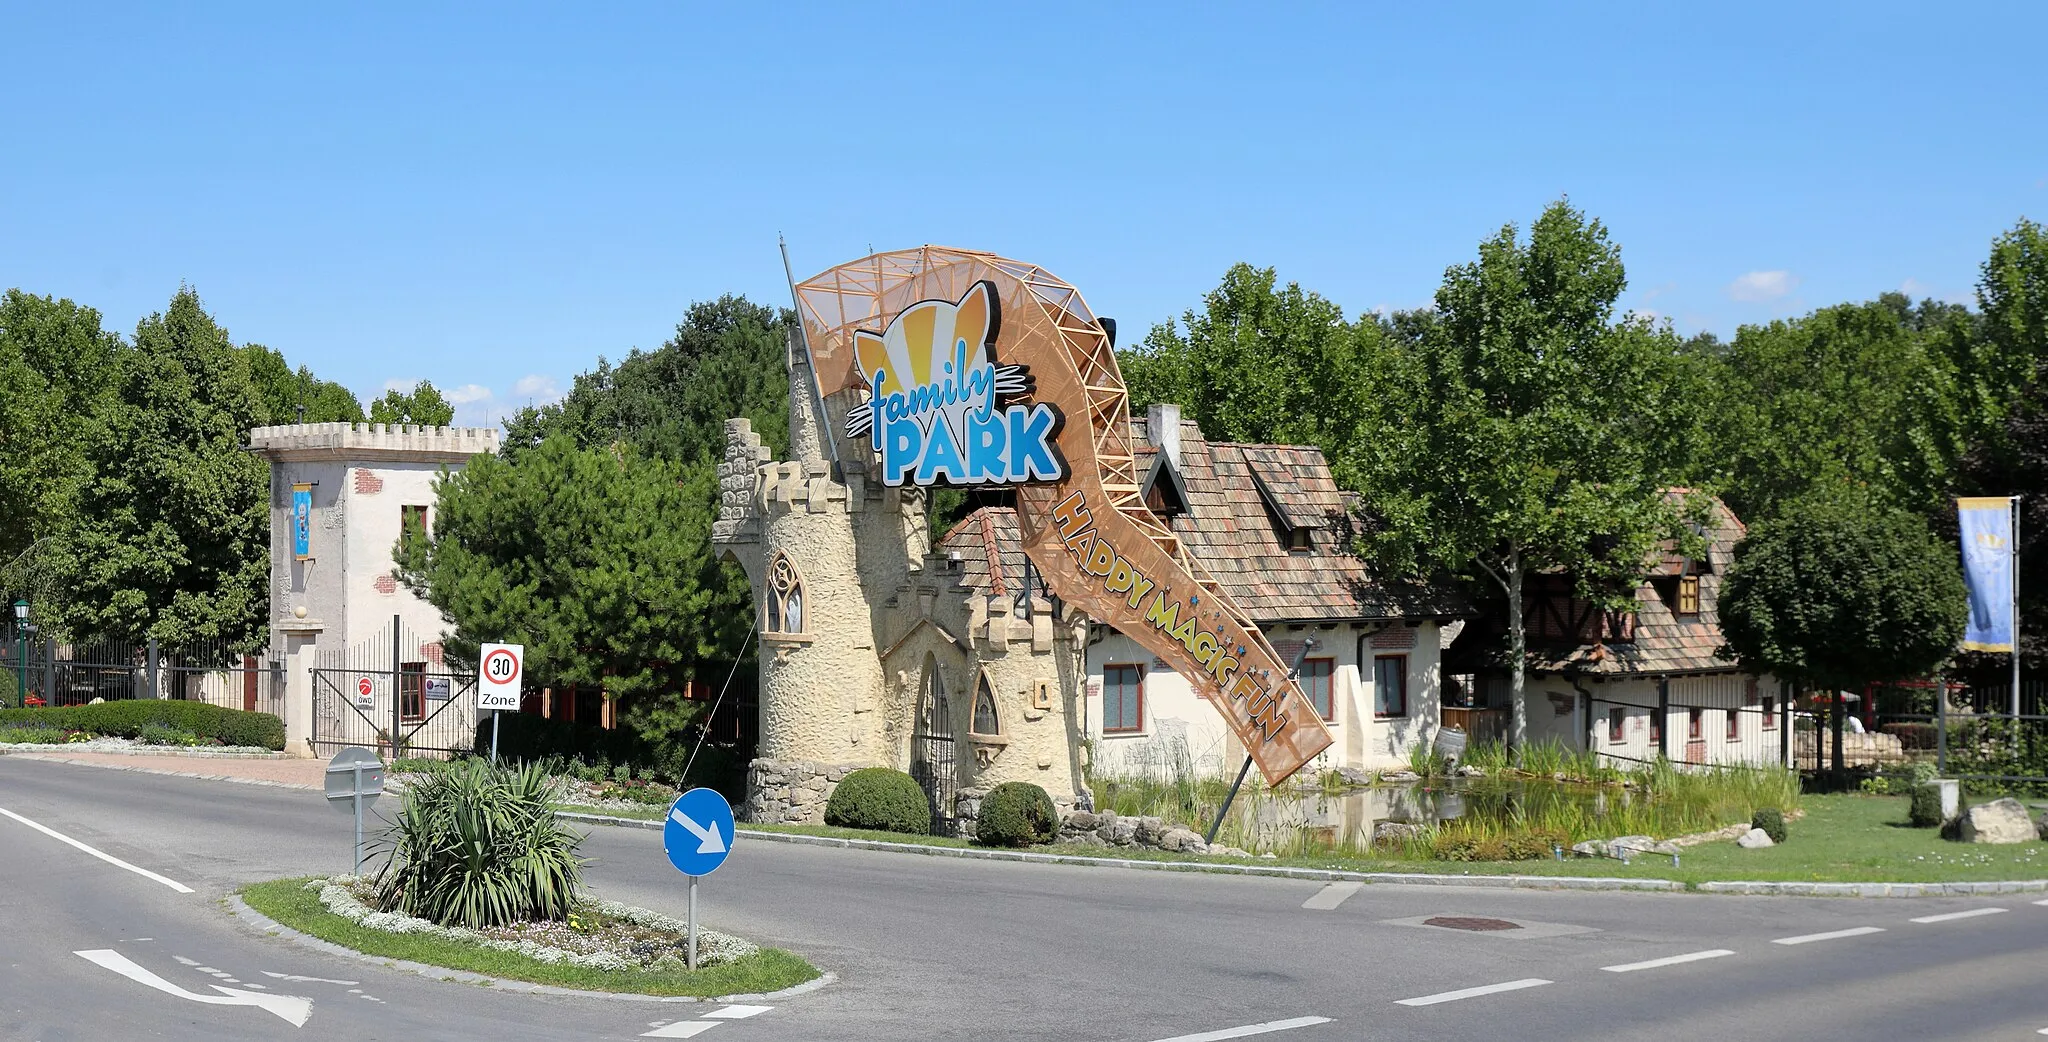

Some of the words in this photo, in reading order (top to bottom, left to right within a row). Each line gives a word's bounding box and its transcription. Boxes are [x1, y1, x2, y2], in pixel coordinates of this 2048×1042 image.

[870, 340, 995, 450] family
[887, 410, 1057, 481] PARK
[1052, 490, 1153, 609] HAPPY
[1146, 590, 1240, 686] MAGIC
[1231, 672, 1287, 742] FUN
[482, 693, 516, 706] Zone
[493, 658, 510, 676] 30
